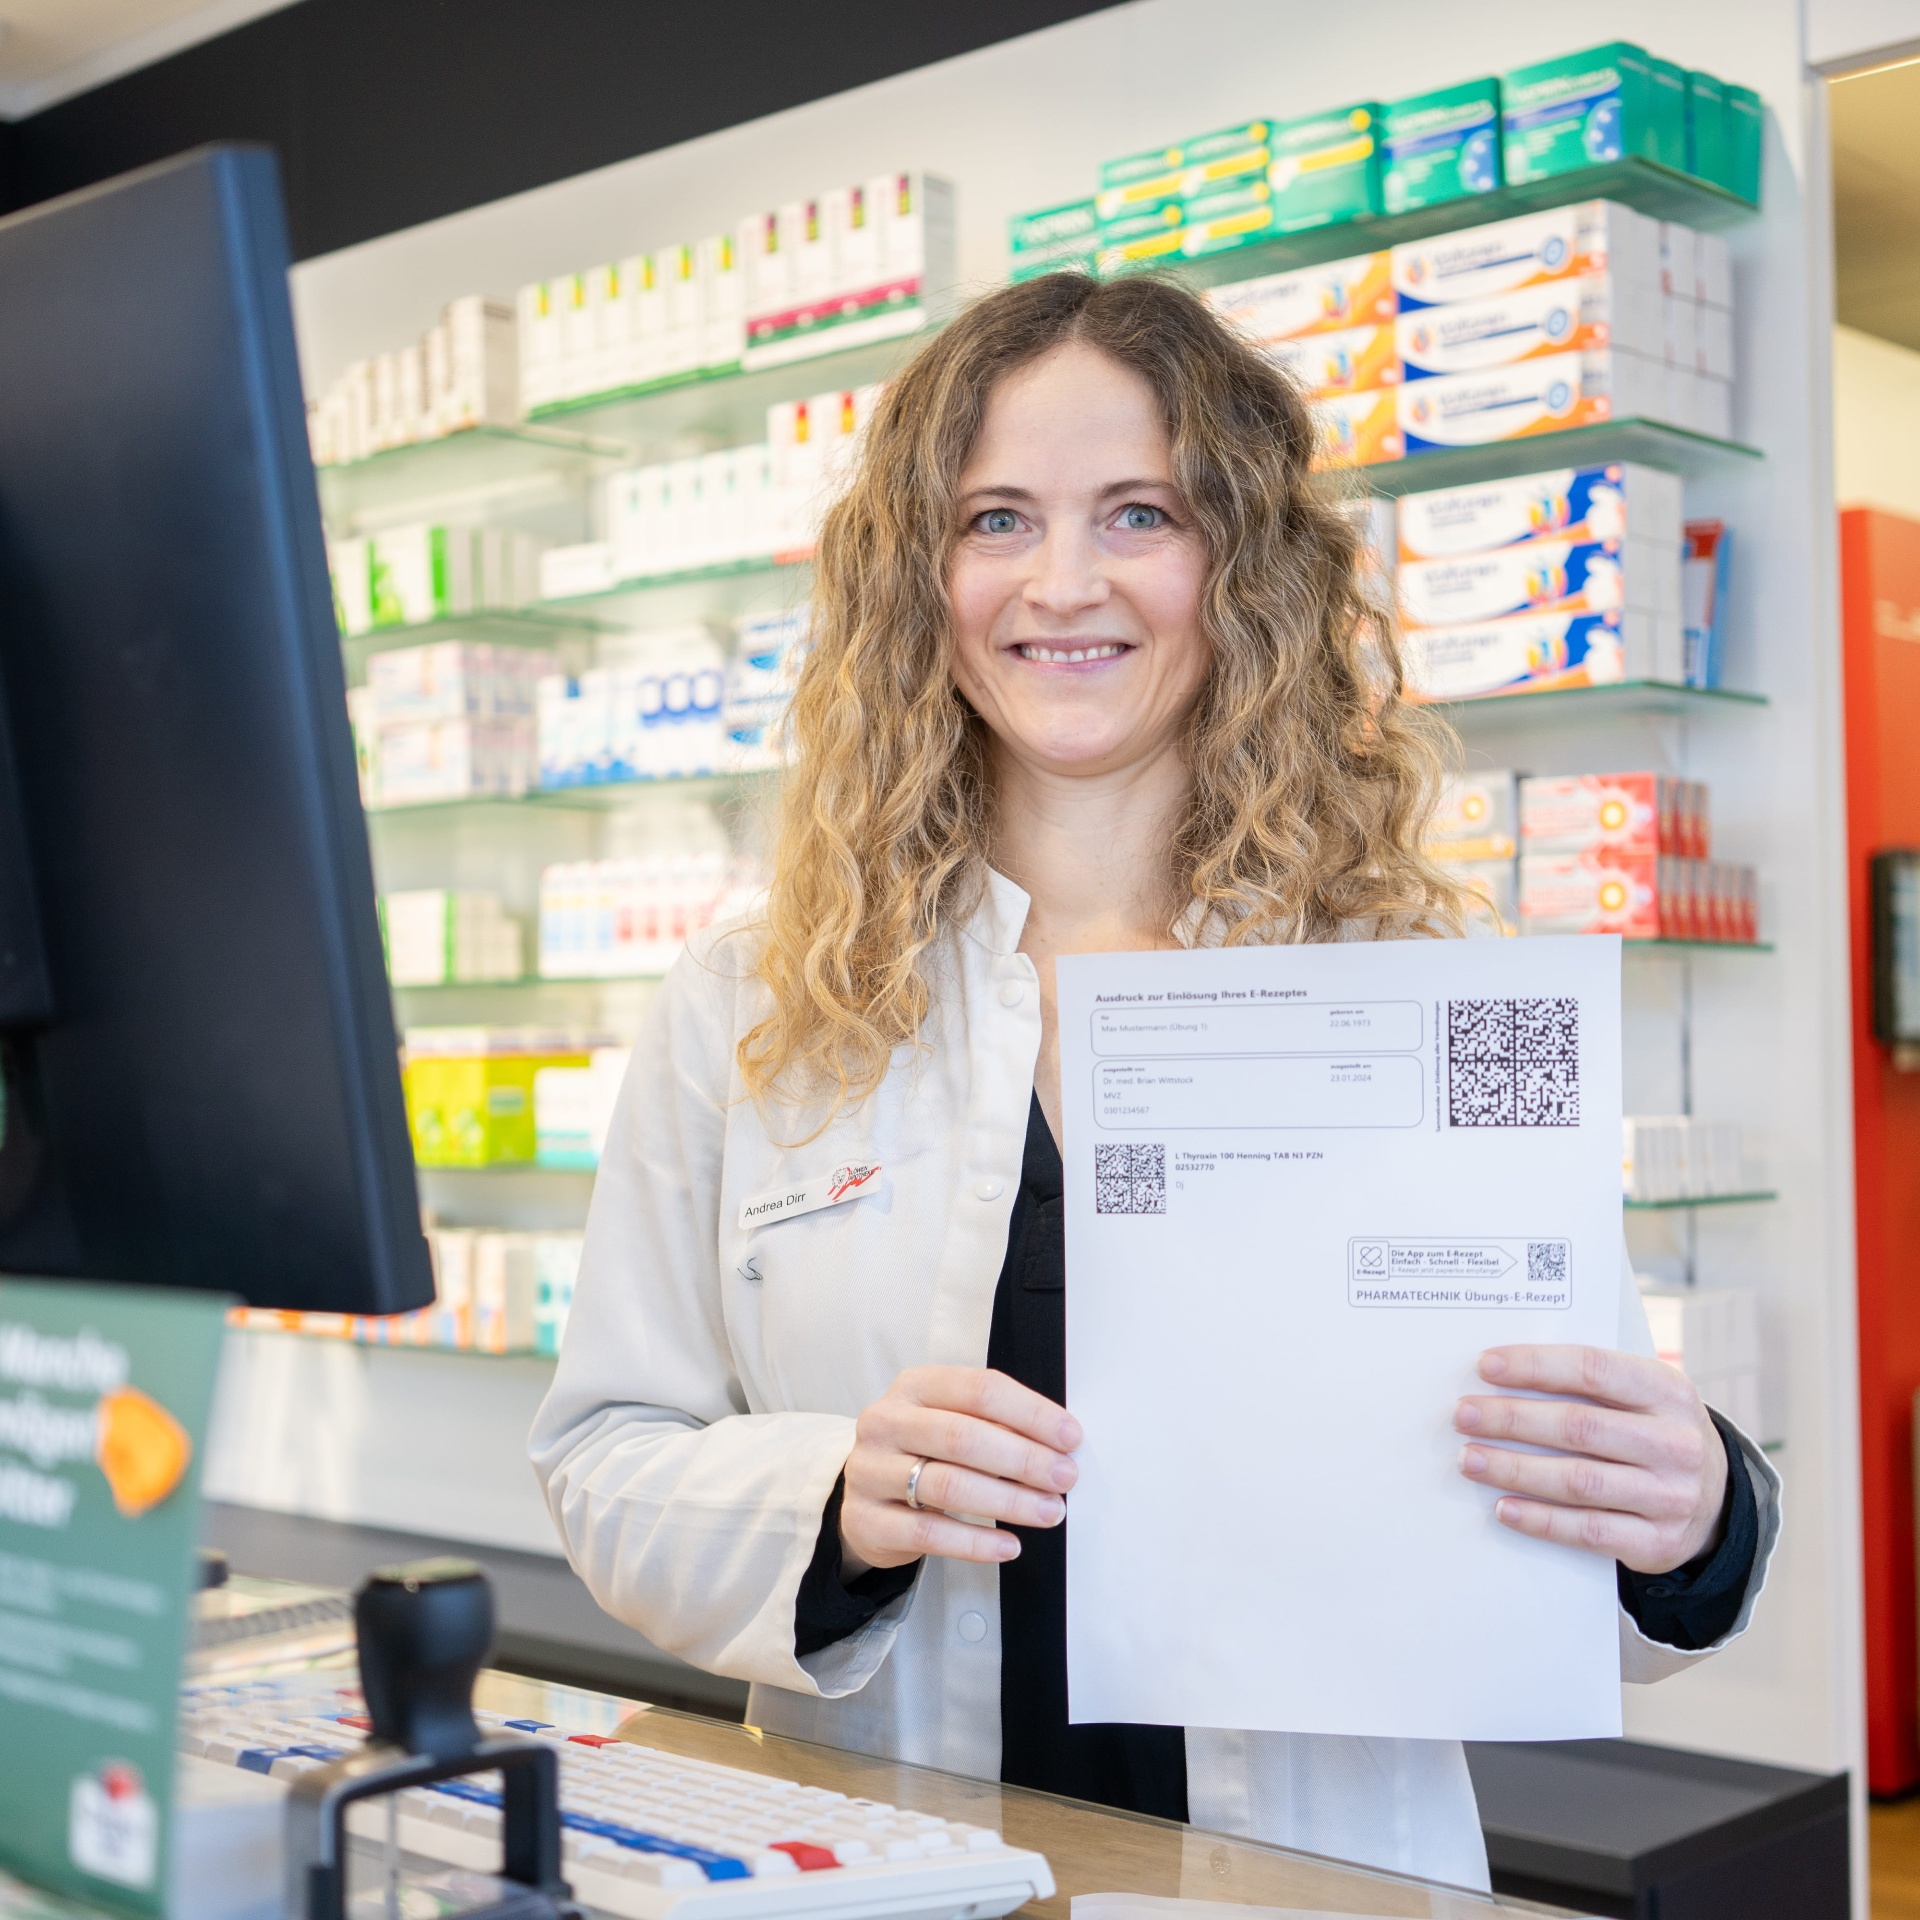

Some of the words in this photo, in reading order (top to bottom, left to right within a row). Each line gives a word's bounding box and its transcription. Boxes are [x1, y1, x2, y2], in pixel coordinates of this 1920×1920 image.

[1095, 994, 1144, 1002] Ausdruck
[1167, 991, 1218, 1001] Einlösung
[1221, 990, 1247, 999] Ihres
[1249, 989, 1307, 1000] E-Rezeptes
[1119, 1023, 1168, 1031] Mustermann
[1169, 1022, 1198, 1031] (Übung
[1200, 1022, 1207, 1030] 1)
[1329, 1019, 1371, 1027] 22.06.1973
[1158, 1076, 1193, 1084] Wittstock
[1330, 1074, 1372, 1082] 23.01.2024
[1103, 1106, 1150, 1114] 0301234567
[1175, 1152, 1180, 1160] L
[1182, 1152, 1217, 1161] Thyroxin
[1220, 1152, 1235, 1160] 100
[1236, 1152, 1271, 1161] Henning
[1274, 1152, 1290, 1160] TAB
[1292, 1152, 1303, 1160] N3
[1306, 1152, 1324, 1160] PZN
[744, 1199, 783, 1218] Andrea
[786, 1192, 806, 1206] Dirr
[1407, 1250, 1424, 1259] App
[1446, 1250, 1483, 1259] E-Rezept
[1391, 1258, 1421, 1266] Einfach
[1429, 1258, 1459, 1266] Schnell
[1467, 1258, 1499, 1266] Flexibel
[1435, 1267, 1464, 1275] papierlos
[1356, 1290, 1461, 1301] PHARMATECHNIK
[1465, 1288, 1566, 1304] Übungs-E-Rezept
